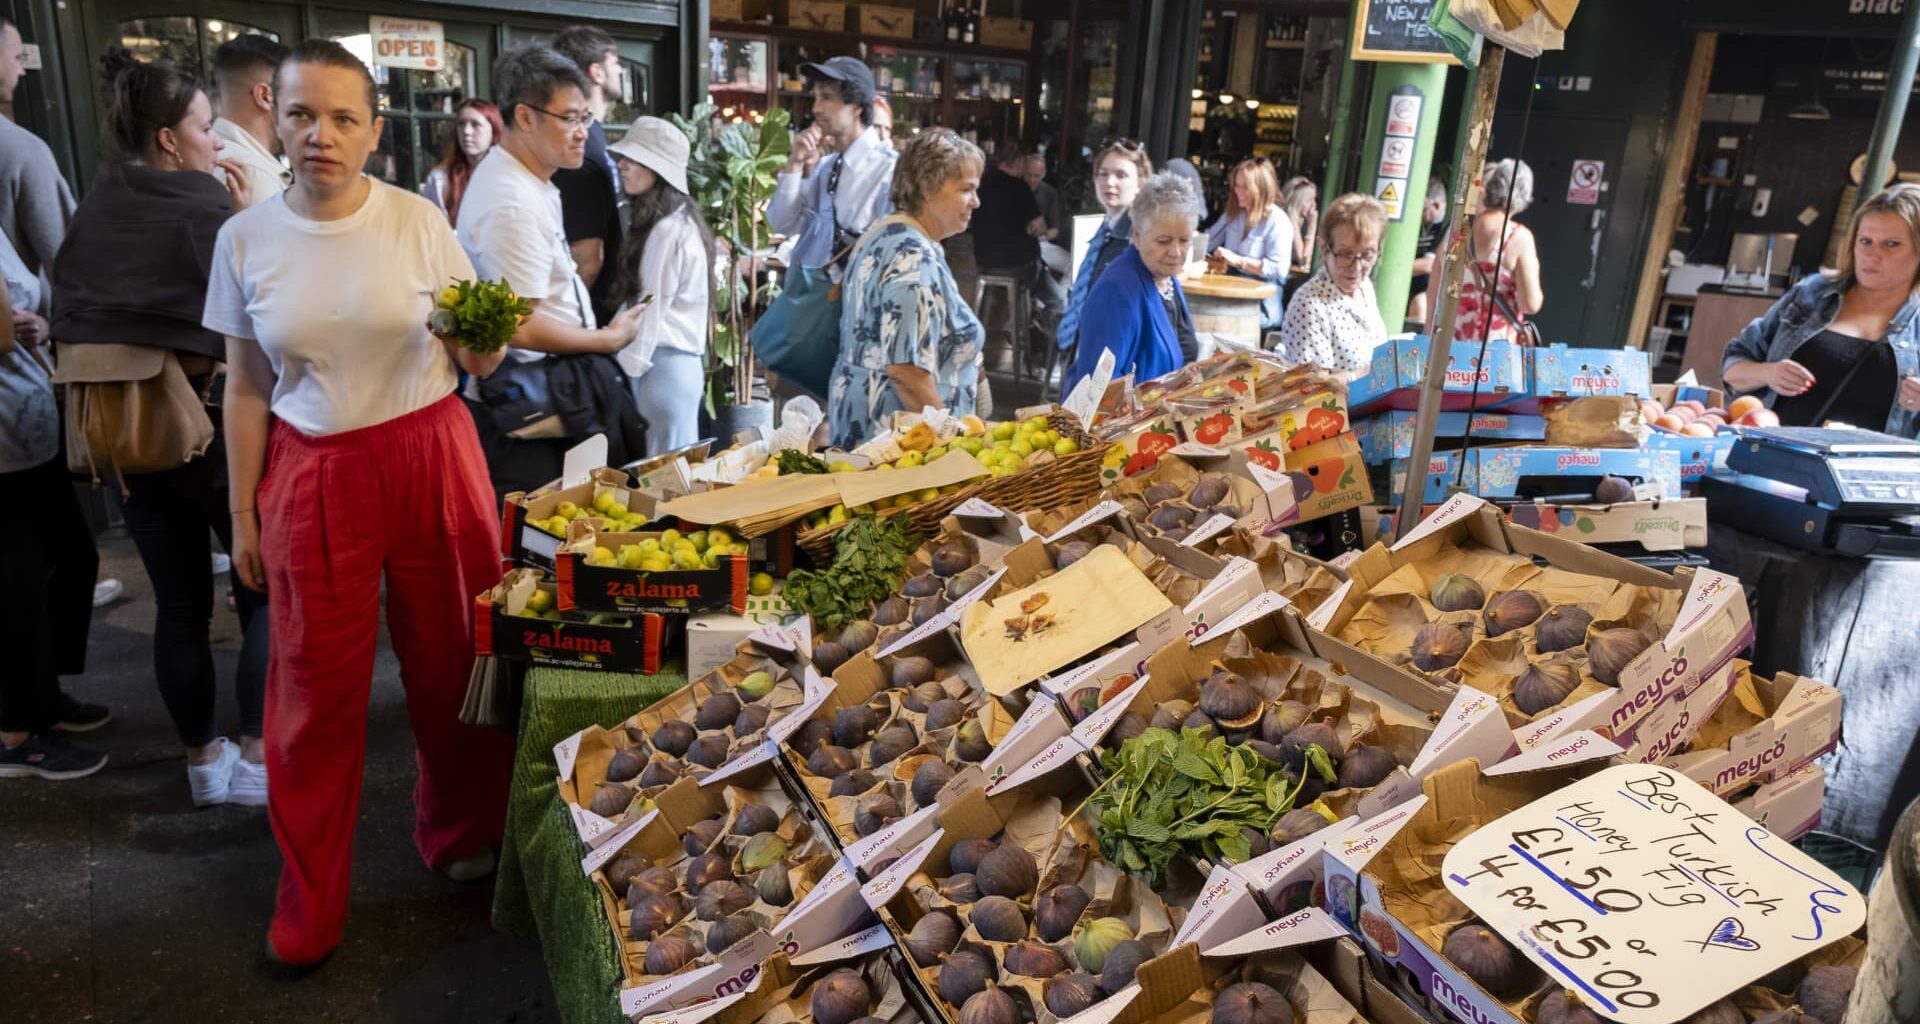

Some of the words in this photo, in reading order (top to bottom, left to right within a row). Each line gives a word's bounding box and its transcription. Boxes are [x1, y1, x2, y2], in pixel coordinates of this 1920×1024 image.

[1385, 5, 1418, 21] NEW
[1404, 22, 1442, 37] ME
[378, 38, 436, 57] OPEN
[607, 576, 700, 598] zalama
[522, 628, 613, 654] zalama
[1625, 771, 1719, 824] Best
[1557, 801, 1639, 855] Honey
[1641, 863, 1706, 907] Fig
[1650, 823, 1784, 917] Turkish
[1465, 854, 1520, 879] 4
[1496, 886, 1548, 911] for
[1511, 827, 1643, 912] £1.50
[1626, 940, 1657, 957] or
